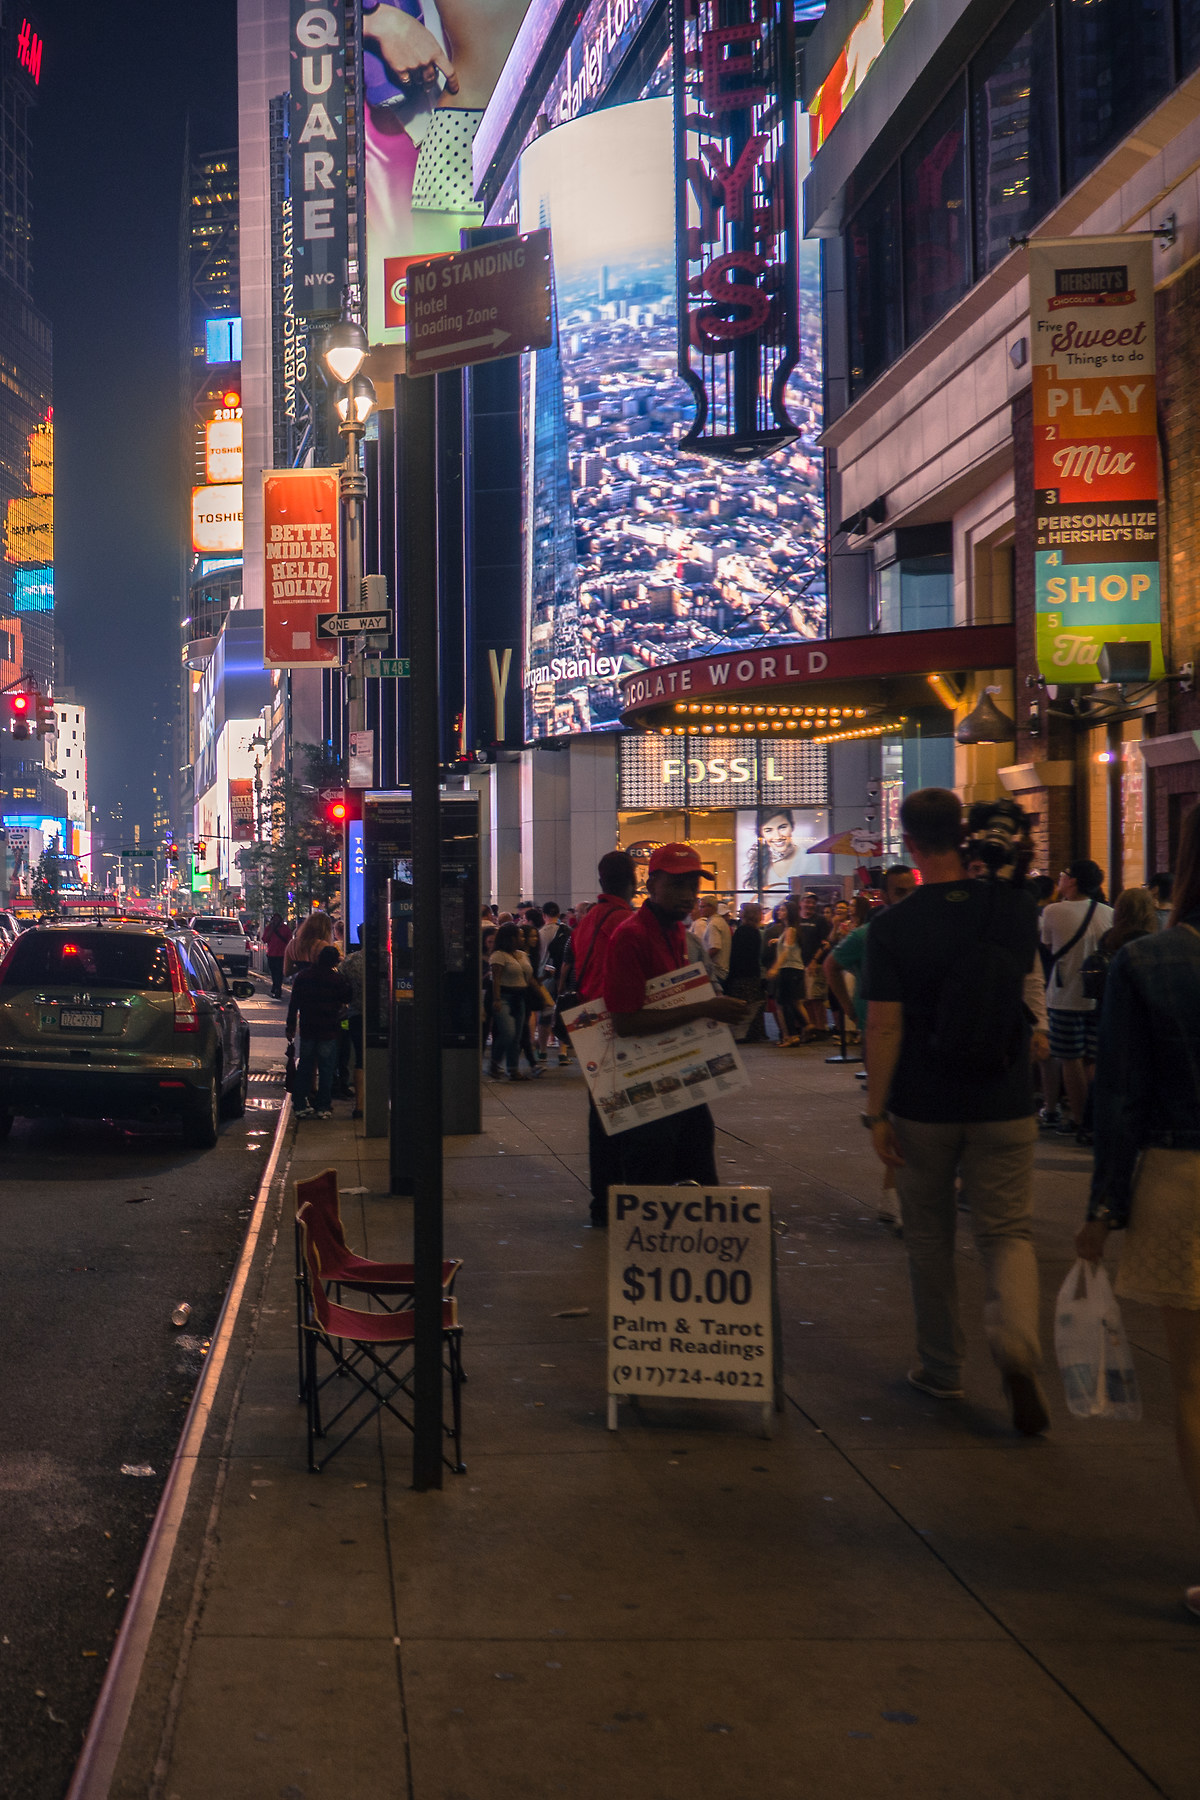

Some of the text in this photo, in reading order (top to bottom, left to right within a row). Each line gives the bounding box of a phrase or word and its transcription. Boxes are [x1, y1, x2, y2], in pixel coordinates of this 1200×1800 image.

[17, 18, 43, 85] H&M
[296, 0, 340, 240] QUARE
[698, 0, 771, 338] EYS
[304, 273, 335, 287] NYC
[414, 248, 526, 295] NO STANDING
[1060, 270, 1124, 291] HERSHEY'S
[282, 196, 297, 418] AMERICAN EAGLE
[415, 295, 448, 317] Hotel
[415, 307, 498, 338] Loading Zone
[1037, 320, 1147, 357] Five Sweet
[1066, 350, 1144, 367] Things to do
[1045, 366, 1053, 380] 1
[1047, 384, 1146, 417] PLAY
[1045, 426, 1056, 440] 2
[1053, 444, 1136, 484] Mix
[1045, 490, 1057, 505] 3
[270, 523, 332, 542] BETTE
[1037, 512, 1158, 531] PERSONALIZE
[1037, 528, 1156, 545] a HERSHEY'S Bar
[266, 541, 336, 560] MIDLER
[1045, 552, 1060, 567] 4
[272, 561, 333, 580] HELLO,
[272, 579, 332, 599] DOLLY!
[1046, 573, 1151, 604] SHOP
[328, 618, 382, 631] ONE WAY
[1047, 614, 1058, 628] 5
[383, 661, 391, 675] W
[392, 661, 404, 675] 48
[550, 653, 624, 680] Stanley
[709, 651, 828, 686] WORLD
[661, 757, 784, 784] FOSSIL
[616, 1194, 761, 1230] Psychic
[626, 1226, 750, 1262] Astrology
[622, 1263, 753, 1306] $10.00
[613, 1316, 764, 1336] Palm & Tarot
[613, 1335, 765, 1361] Card Readings
[613, 1365, 765, 1388] (917)724-4022
